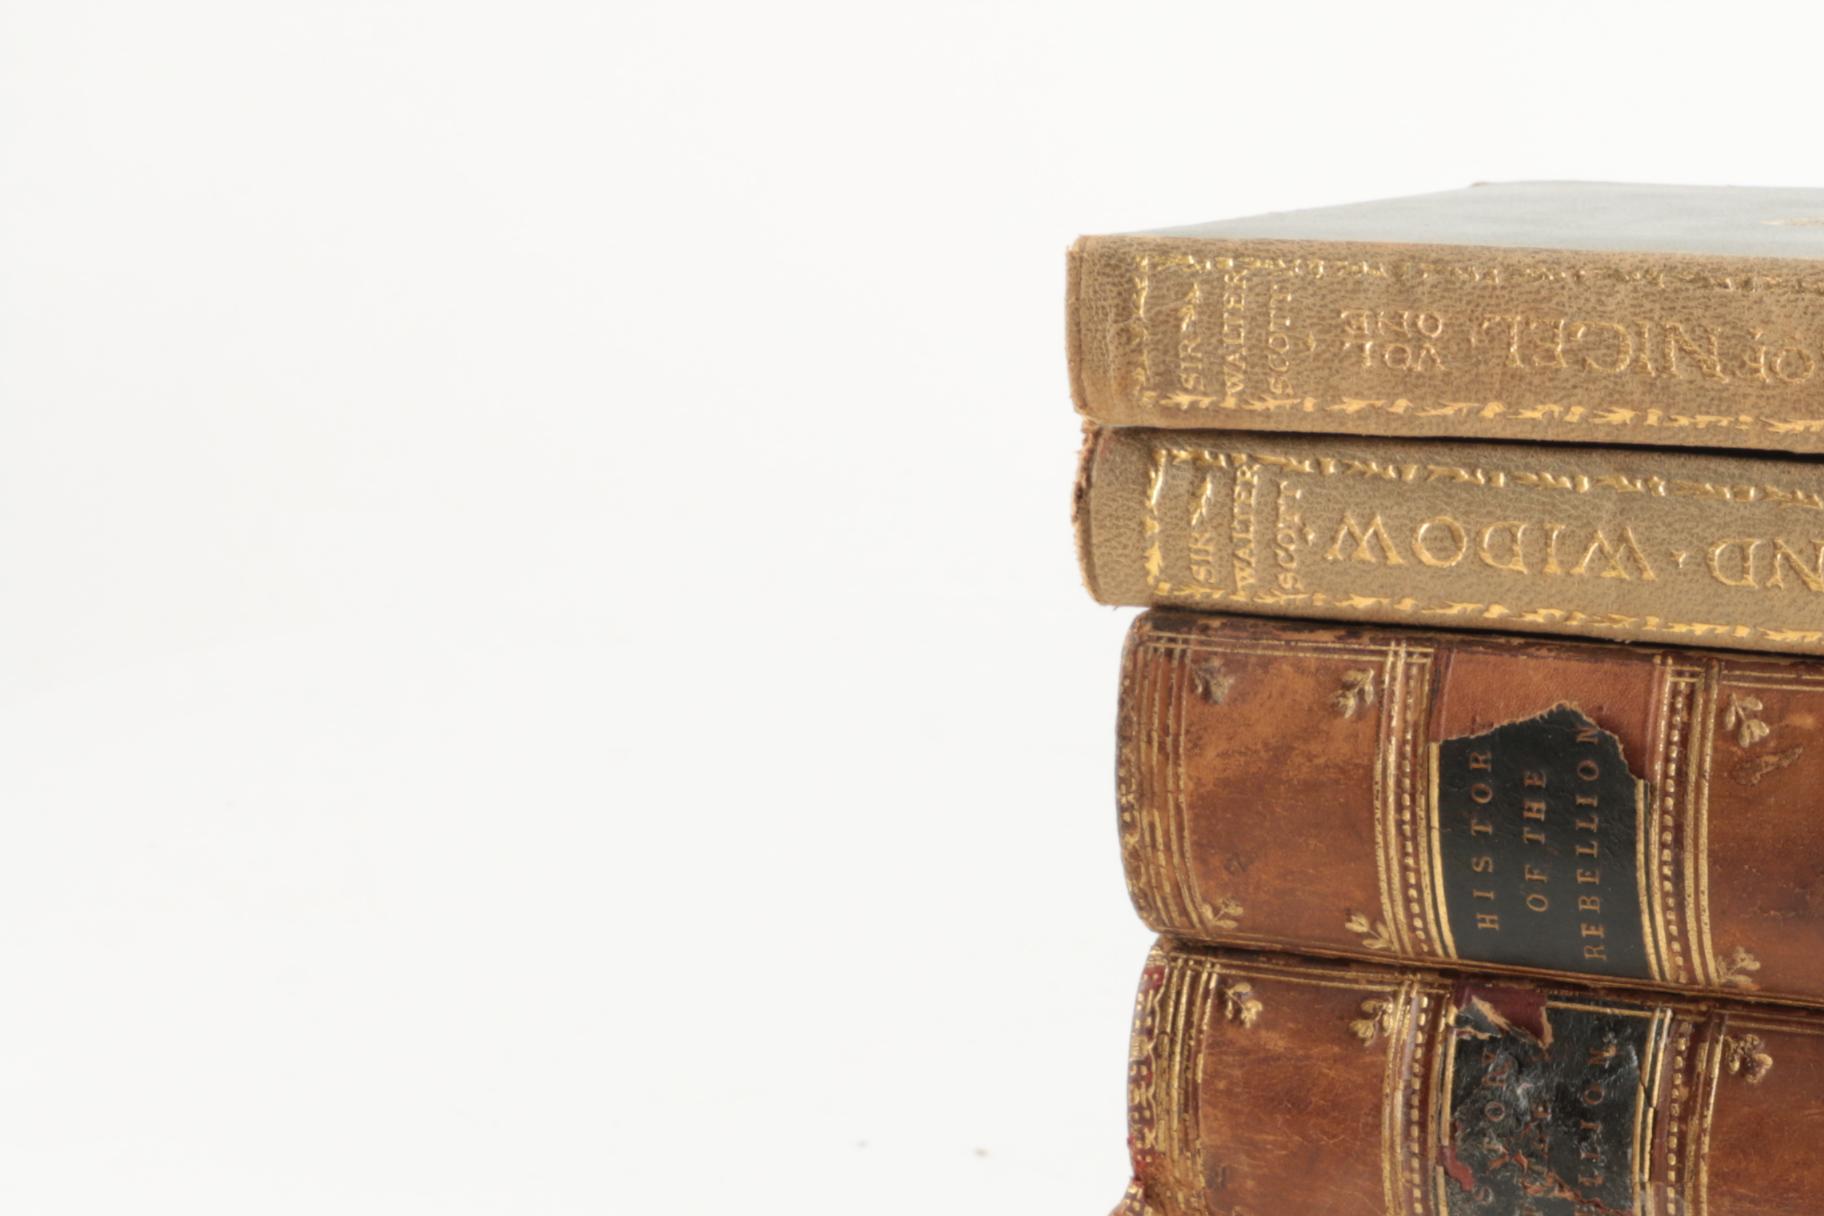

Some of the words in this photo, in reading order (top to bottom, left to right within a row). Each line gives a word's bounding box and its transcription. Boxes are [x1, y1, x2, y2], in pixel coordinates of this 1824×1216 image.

[1224, 270, 1249, 394] WALTER
[1340, 308, 1443, 338] ONE
[1359, 340, 1447, 371] VOL
[1472, 312, 1730, 383] NIGEL
[1190, 532, 1214, 583] SIR
[1232, 465, 1260, 591] WALTER
[1274, 481, 1304, 592] SCOTT
[1324, 511, 1659, 582] WIDOW
[1523, 770, 1547, 846] THE
[1576, 727, 1607, 961] REBELLION
[1525, 864, 1549, 913] OF
